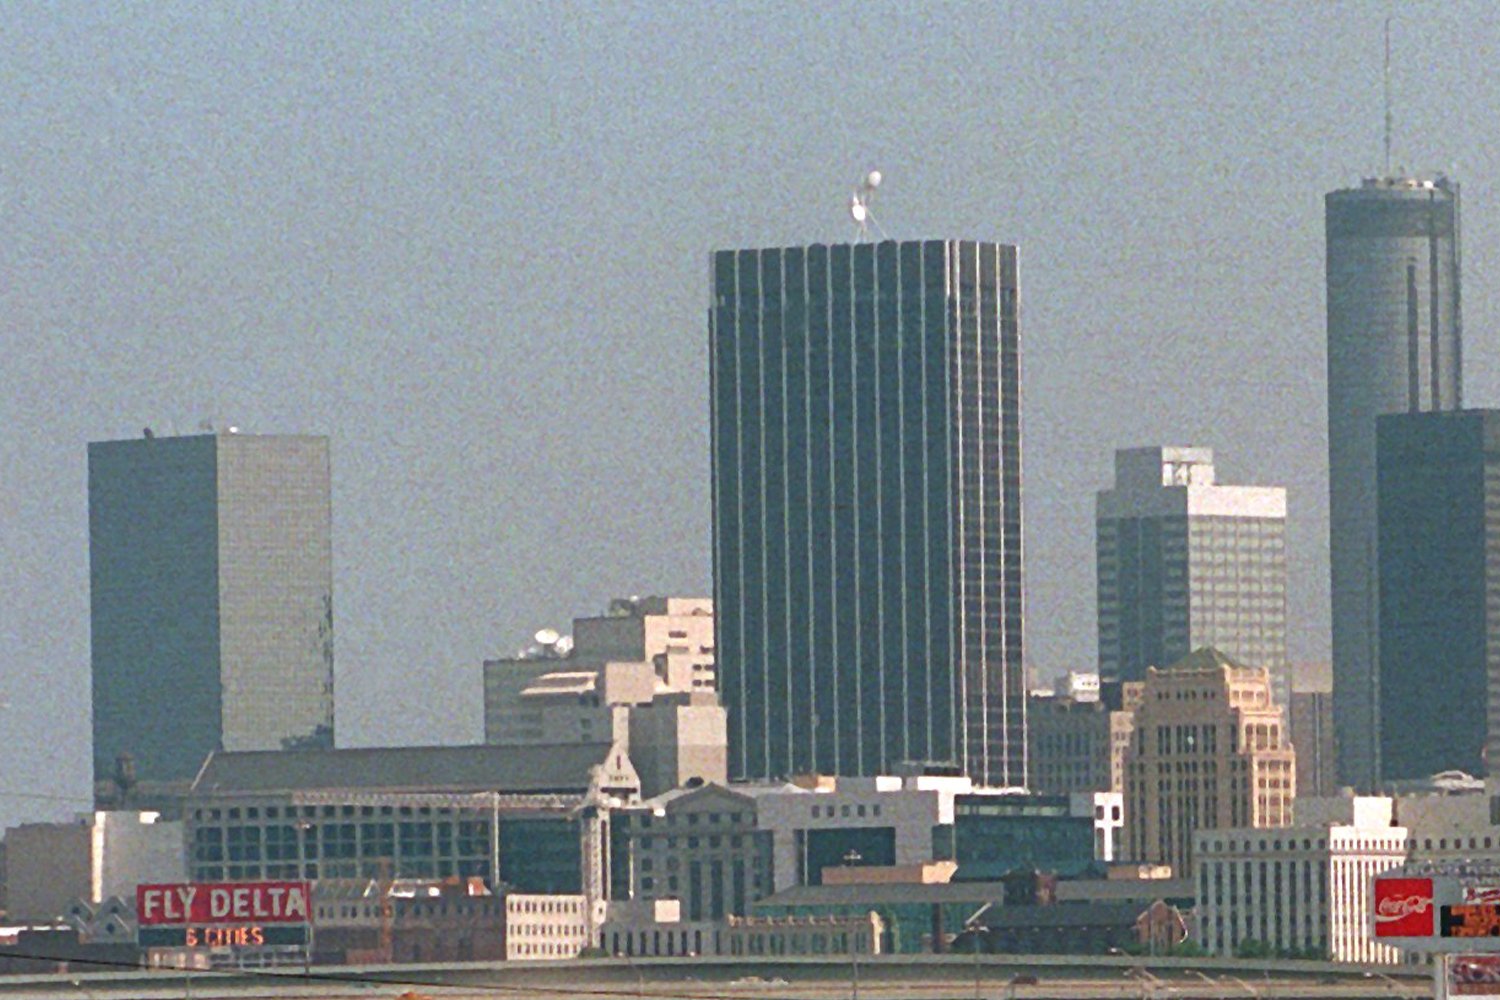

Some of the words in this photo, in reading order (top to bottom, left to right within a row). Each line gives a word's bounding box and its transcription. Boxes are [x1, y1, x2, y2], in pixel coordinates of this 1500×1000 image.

[144, 886, 197, 919] FLY
[210, 887, 306, 918] DELTA
[205, 927, 265, 947] CITIES
